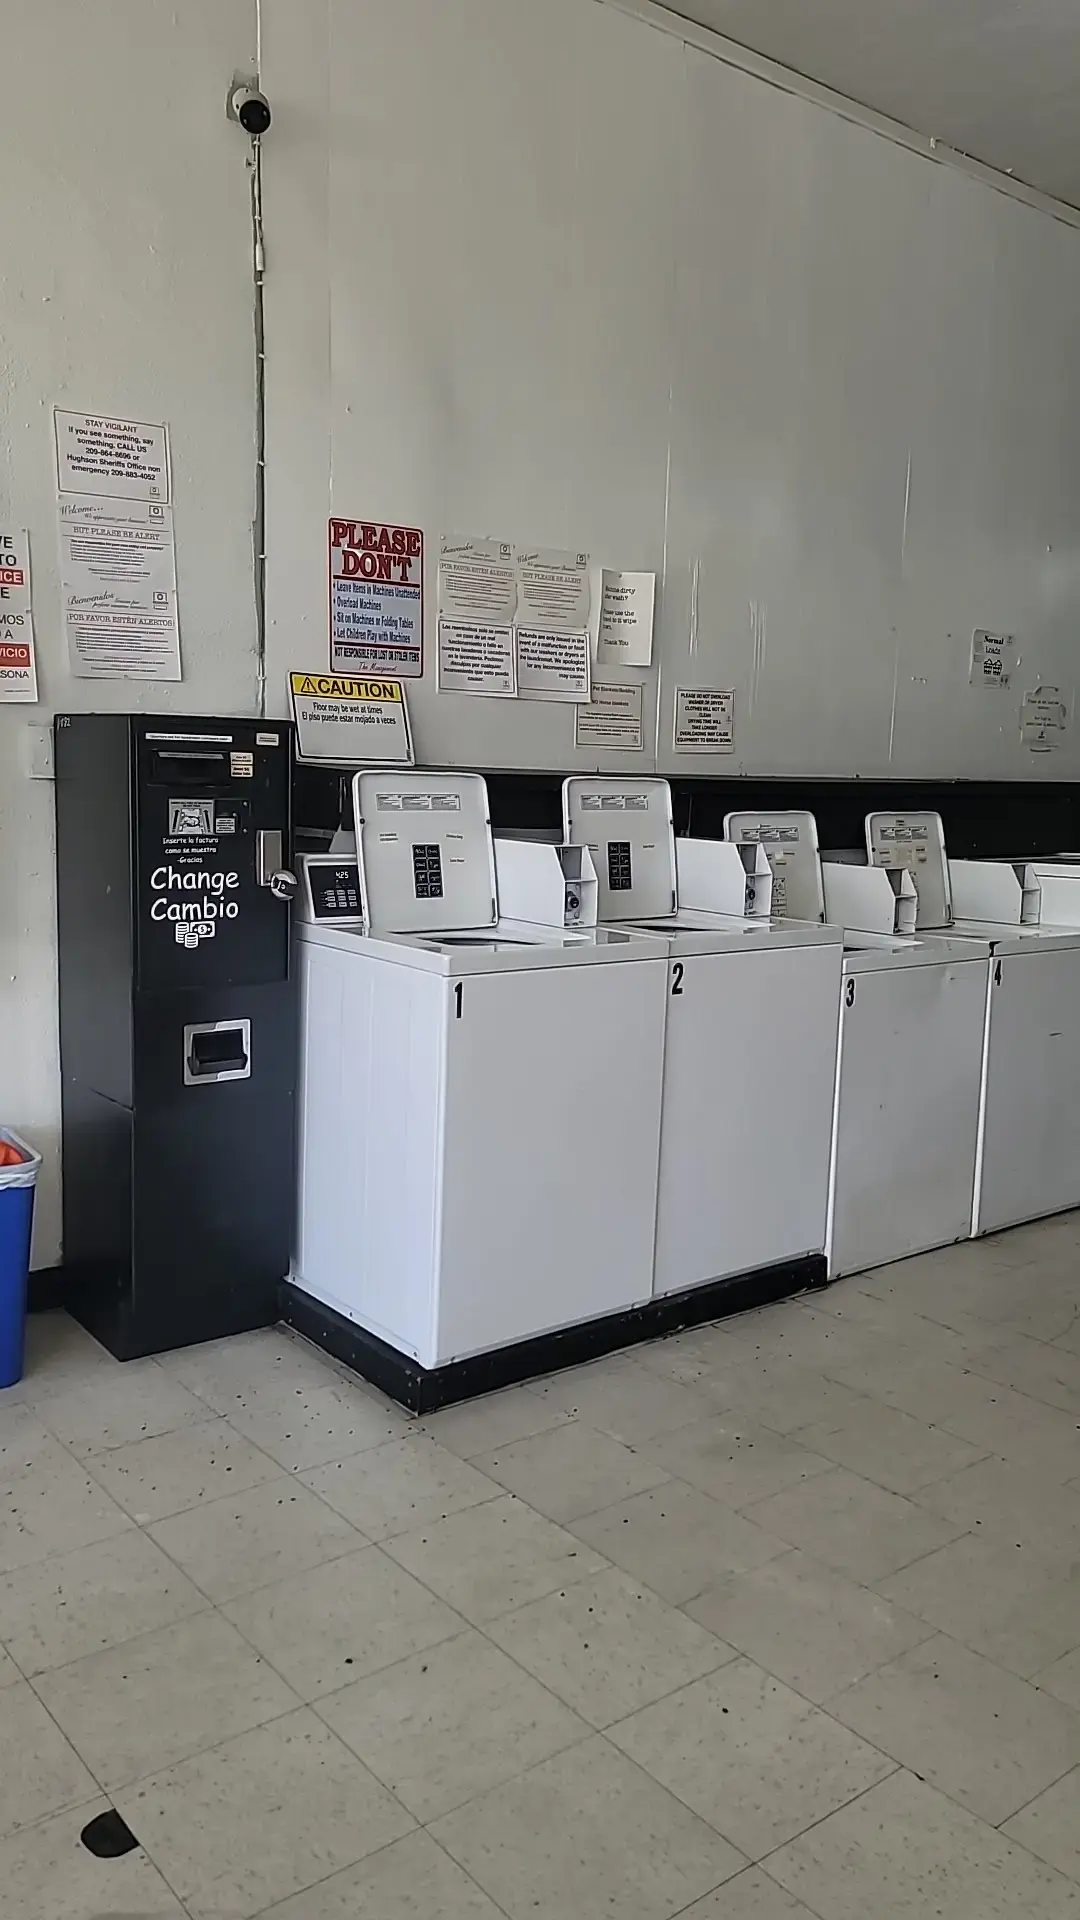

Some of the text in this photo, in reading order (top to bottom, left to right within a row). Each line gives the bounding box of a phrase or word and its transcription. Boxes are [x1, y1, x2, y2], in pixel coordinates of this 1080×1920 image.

[85, 419, 137, 433] STAY VIGILANT
[68, 425, 74, 433] If
[75, 427, 88, 436] you
[89, 429, 102, 437] see
[142, 438, 154, 446] say
[117, 442, 135, 452] CALL
[137, 445, 147, 453] US
[67, 453, 98, 465] Hughson
[126, 461, 146, 471] Office
[71, 464, 110, 476] emergency
[73, 526, 89, 534] BUT
[91, 528, 121, 537] PLEASE
[135, 531, 160, 540] ALERT
[332, 521, 420, 557] PLEASE
[342, 549, 412, 581] DON'T
[337, 581, 420, 600] Leave Items in Machines Unattended
[620, 587, 636, 595] dirty
[337, 596, 381, 611] Overload Machines
[345, 614, 351, 623] on
[352, 613, 375, 625] Machines
[376, 617, 381, 626] or
[381, 616, 398, 630] Folding
[399, 617, 414, 628] Tables
[337, 627, 411, 643] Let Children Play with Machines
[984, 635, 1004, 644] Normal
[344, 647, 370, 659] RESPONSIBLE
[370, 648, 378, 659] FOR
[378, 649, 388, 660] LOST
[394, 651, 408, 662] STOLEN
[409, 652, 420, 663] ITEMS
[359, 661, 368, 671] The
[318, 679, 395, 698] CAUTION
[313, 702, 383, 714] Floor may be wet at times
[302, 711, 308, 720] El
[309, 713, 321, 723] piso
[321, 713, 338, 723] puede
[339, 715, 354, 723] estar
[355, 716, 375, 725] mojado
[381, 717, 396, 725] veces
[150, 866, 240, 896] Change
[150, 896, 239, 920] Cambio
[671, 963, 684, 995] 2
[994, 960, 1002, 986] 4
[455, 982, 463, 1019] 1
[845, 979, 855, 1007] 3
